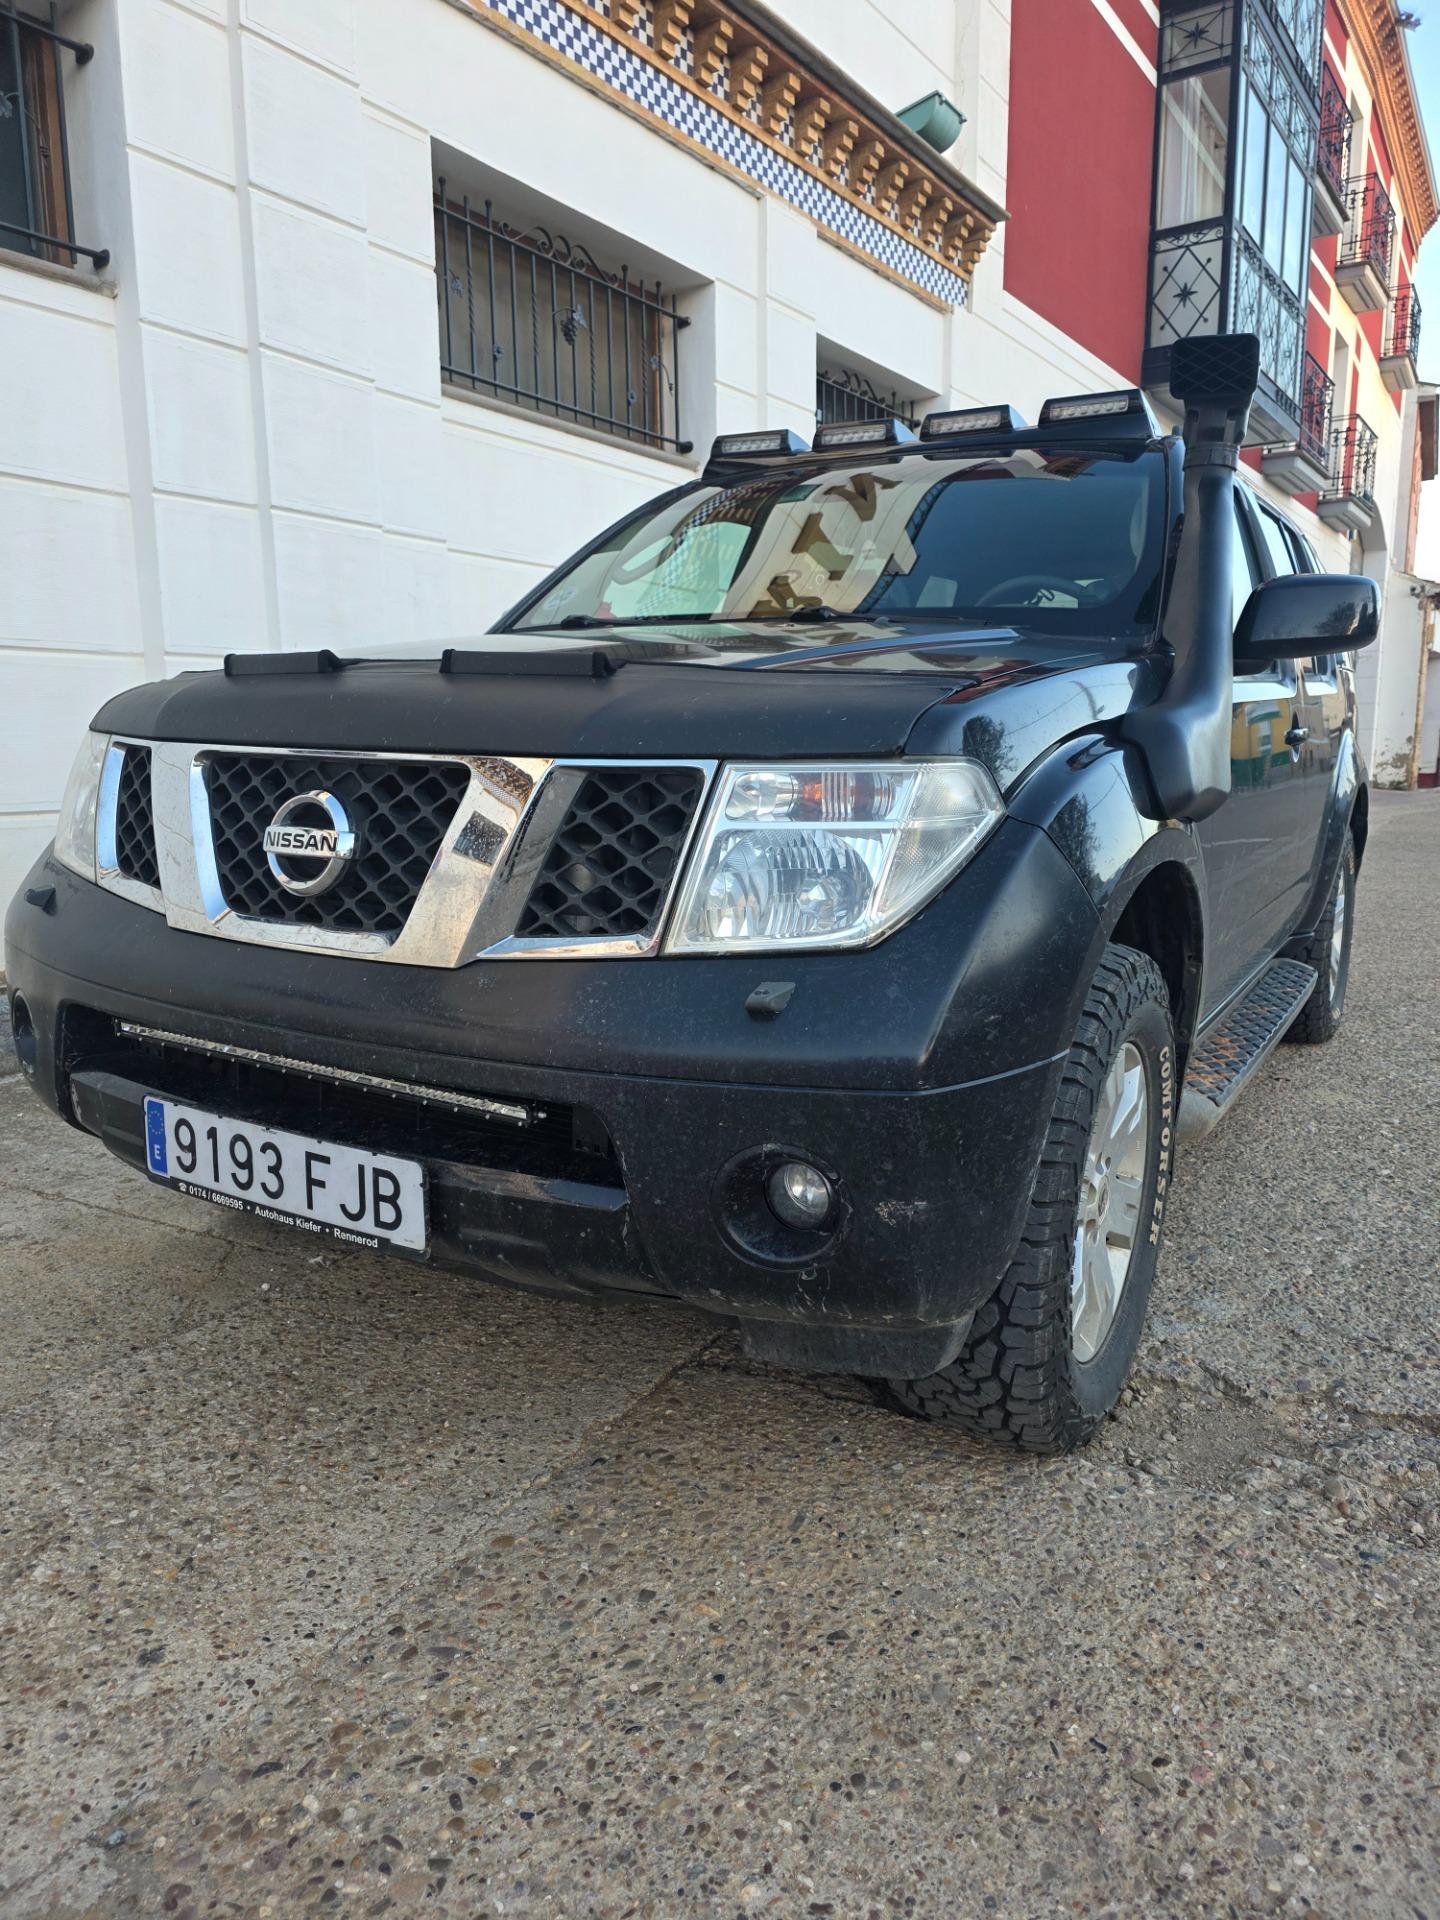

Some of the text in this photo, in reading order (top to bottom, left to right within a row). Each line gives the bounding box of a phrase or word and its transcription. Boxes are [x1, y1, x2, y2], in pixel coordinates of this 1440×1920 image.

[265, 831, 338, 852] NISSAN
[153, 1144, 162, 1160] E
[174, 1117, 285, 1200] 9193
[1149, 1046, 1171, 1246] COMFORSER
[189, 1185, 207, 1199] 0174
[212, 1192, 244, 1211] 6669595
[254, 1206, 295, 1226] Autohaus
[296, 1217, 322, 1233] Kiefer
[334, 1228, 379, 1248] Rennerod
